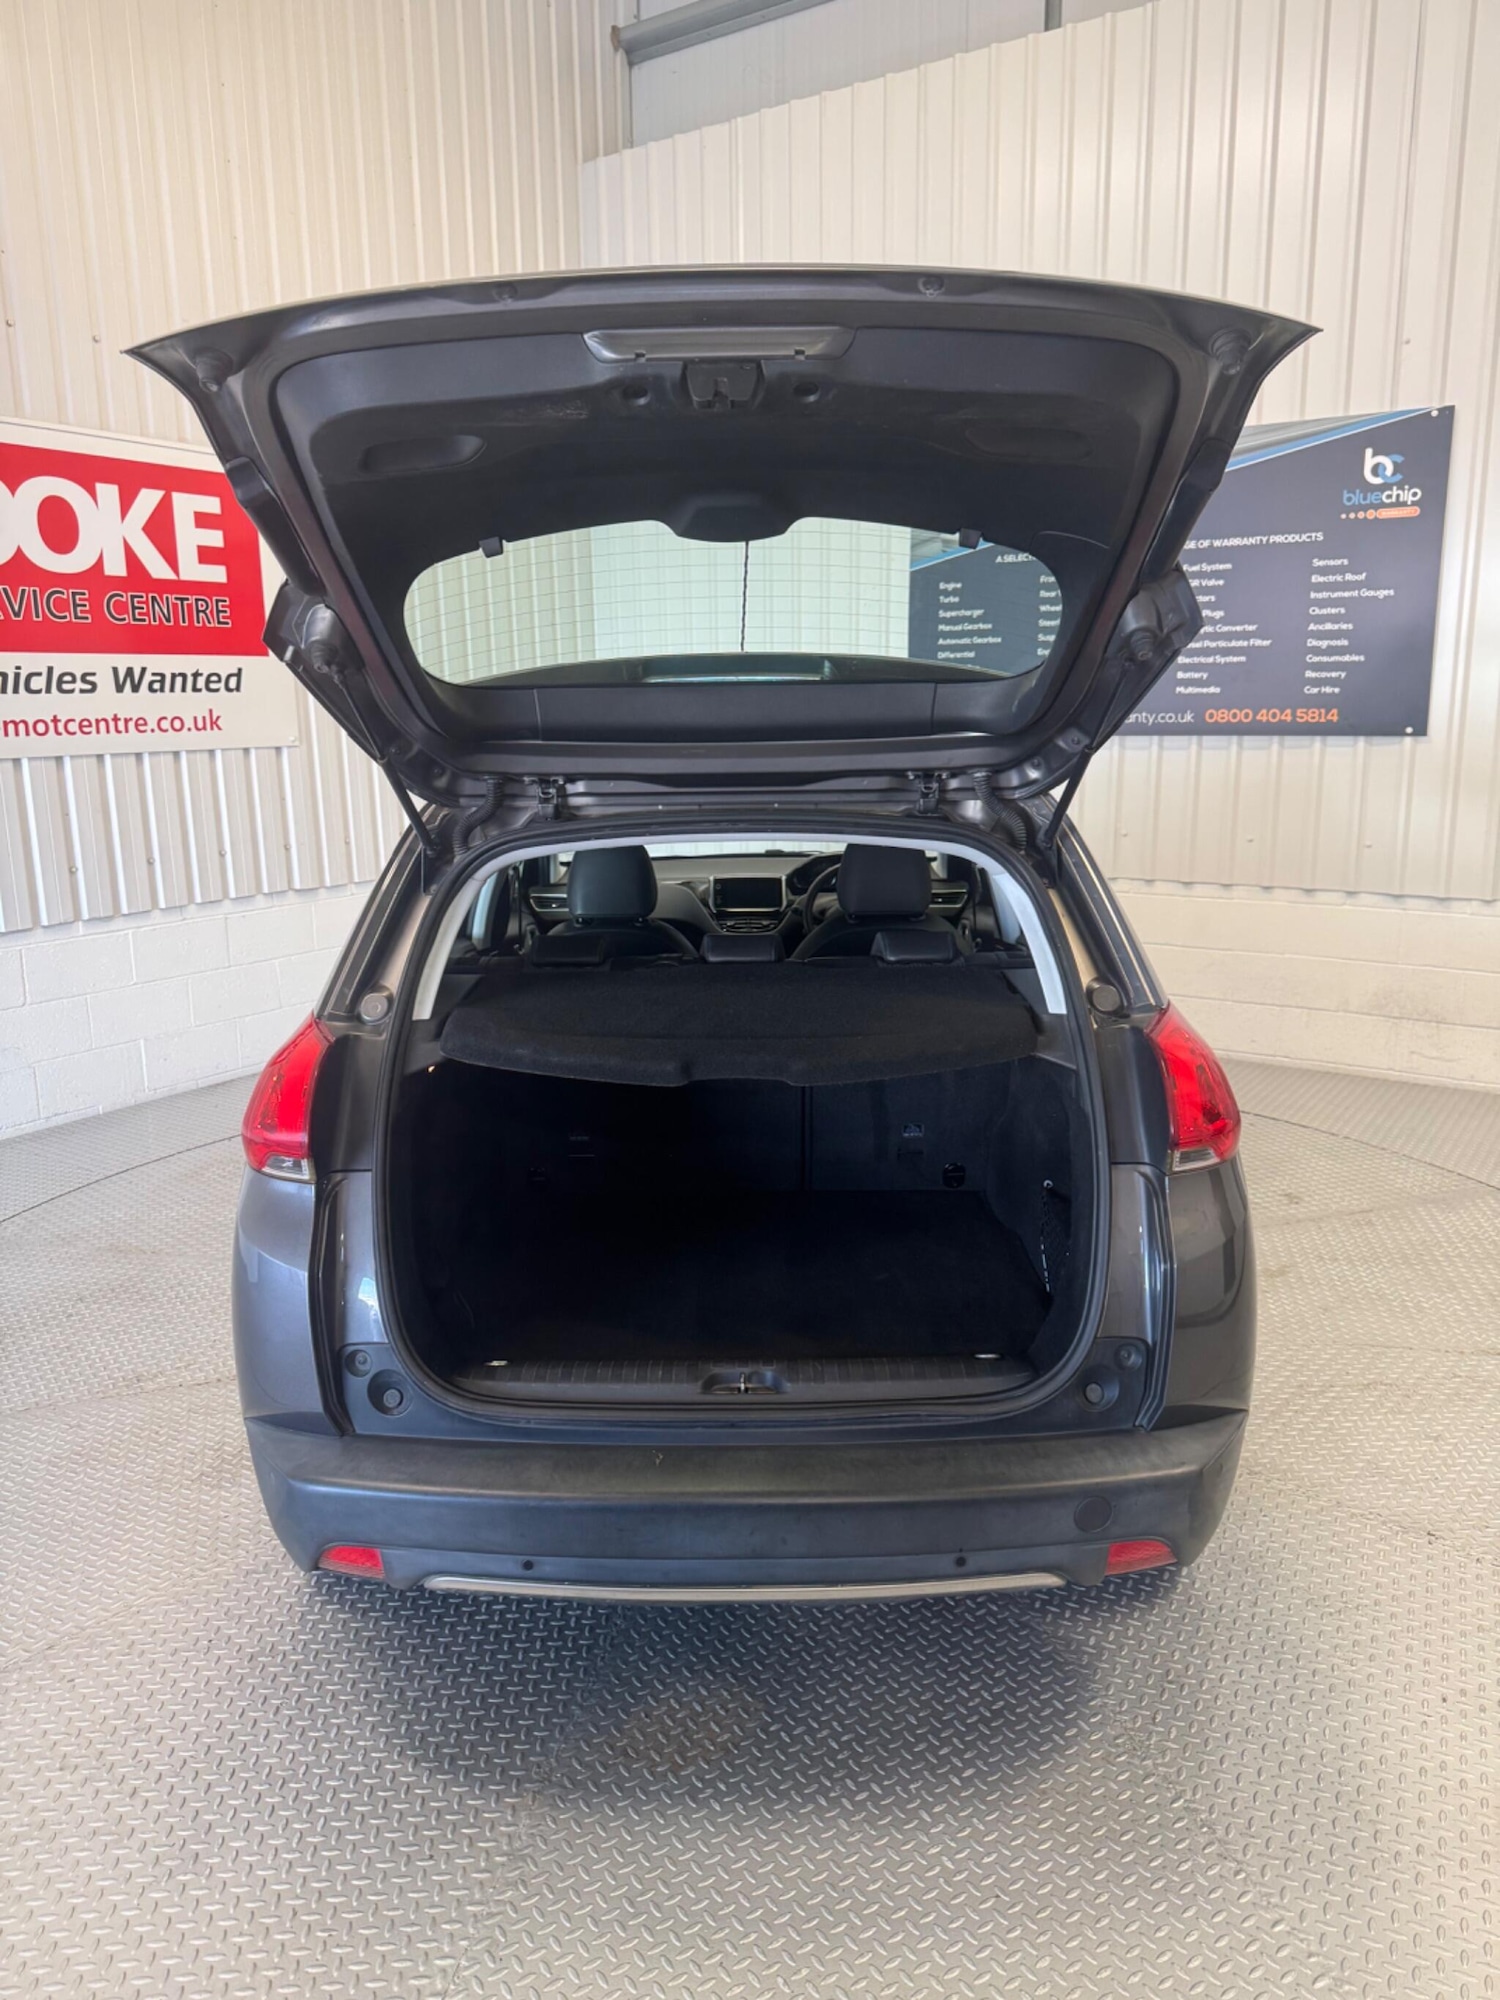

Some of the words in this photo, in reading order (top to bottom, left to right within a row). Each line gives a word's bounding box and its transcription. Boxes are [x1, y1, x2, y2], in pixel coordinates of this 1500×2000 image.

[1342, 485, 1422, 506] bluechip
[0, 475, 228, 584] OKE
[1198, 539, 1211, 549] OF
[1212, 535, 1269, 548] WARRANTY
[1269, 532, 1324, 545] PRODUCTS
[1201, 562, 1233, 573] System
[1312, 558, 1349, 568] Sensors
[1201, 578, 1225, 587] Valve
[1311, 574, 1344, 583] Electric
[1344, 572, 1367, 582] Roof
[1310, 589, 1359, 599] Instrument
[1359, 588, 1395, 600] Gauges
[0, 584, 91, 623] VICE
[104, 590, 232, 628] CENTRE
[1201, 609, 1225, 620] Plugs
[1215, 623, 1258, 633] Converter
[1307, 622, 1354, 632] Ancillaries
[1203, 639, 1249, 649] Particulate
[1249, 637, 1273, 647] Filter
[1306, 638, 1350, 649] Diagnosis
[1177, 655, 1214, 664] Electrical
[1214, 654, 1247, 665] System
[1305, 654, 1366, 663] Consumables
[111, 666, 244, 694] Wanted
[1176, 670, 1209, 681] Battery
[1304, 670, 1348, 680] Recovery
[1175, 685, 1222, 695] Multimedia
[1303, 685, 1320, 695] Car
[1320, 685, 1341, 694] Hire
[1204, 708, 1253, 723] 0800
[1255, 708, 1293, 723] 404
[1295, 708, 1339, 723] 5814
[0, 708, 224, 738] motcentre.co.uk
